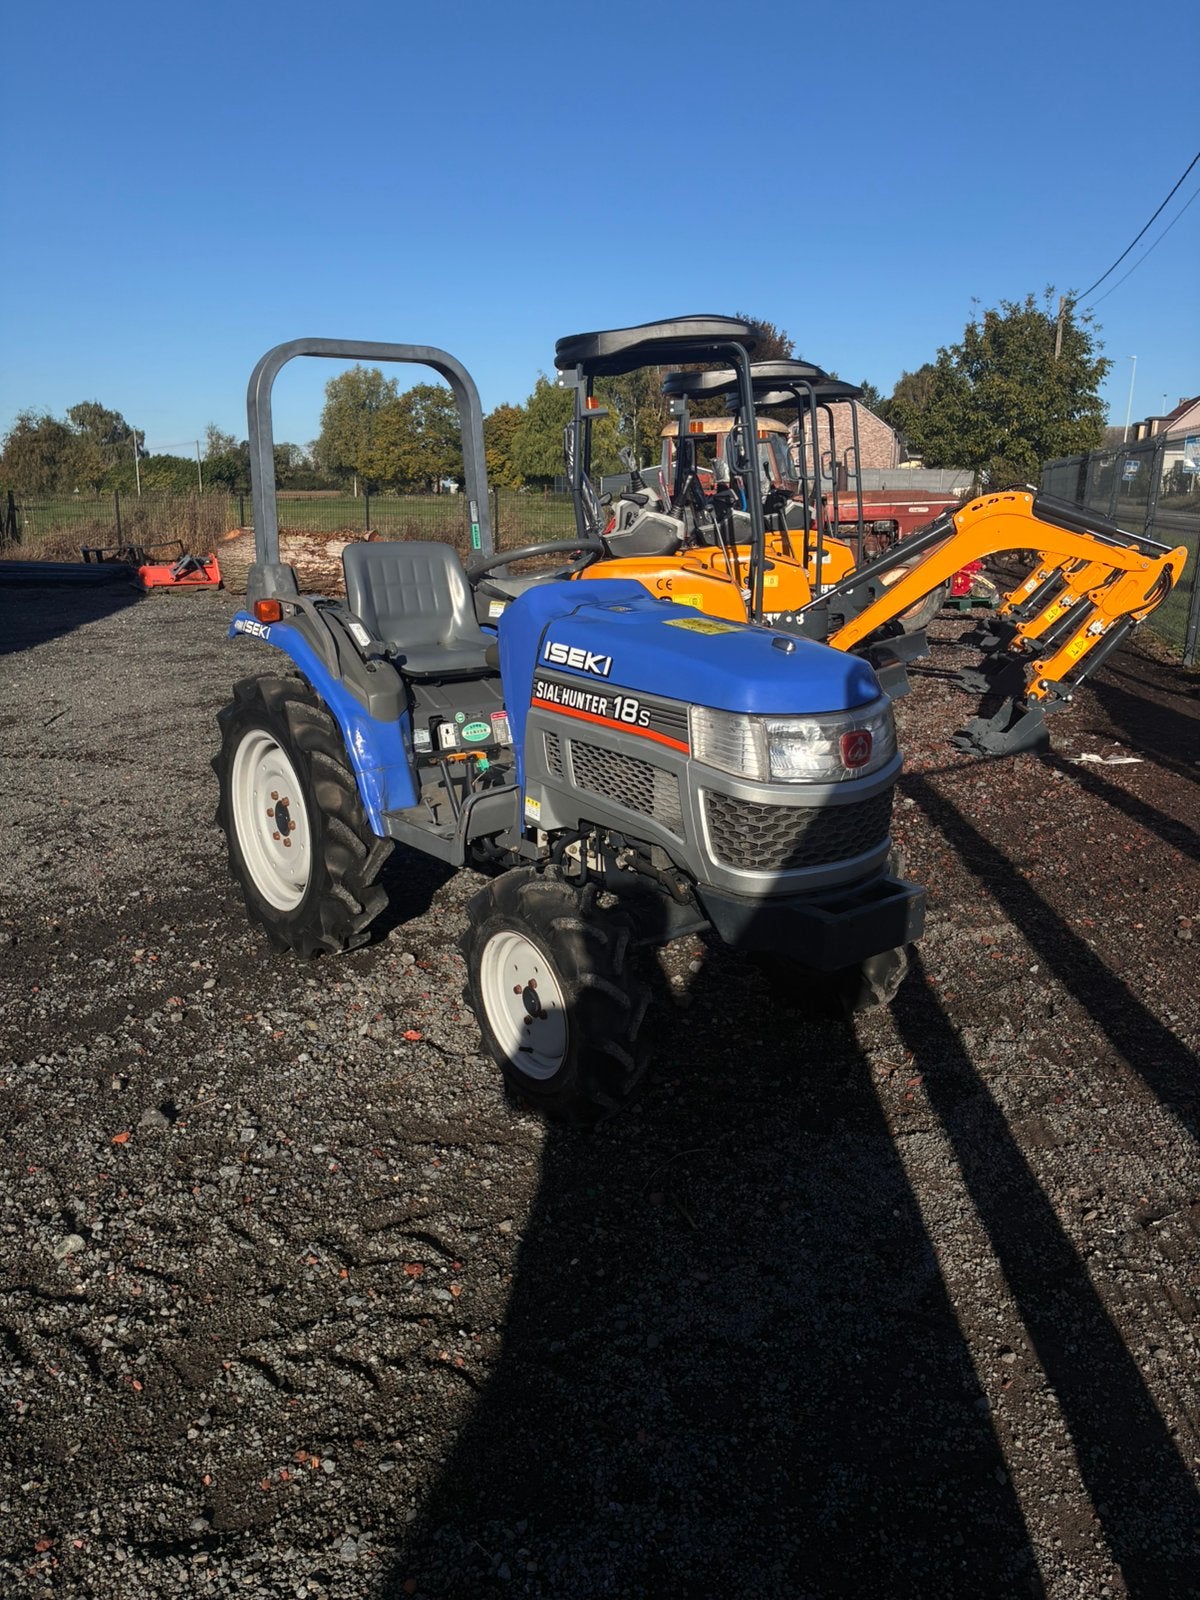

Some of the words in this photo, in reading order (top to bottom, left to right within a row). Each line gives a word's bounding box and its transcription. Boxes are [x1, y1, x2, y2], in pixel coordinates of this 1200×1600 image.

[243, 619, 271, 640] ISEKI
[543, 641, 612, 676] ISEKI
[536, 681, 560, 704] SIAL
[561, 687, 608, 716] HUNTER
